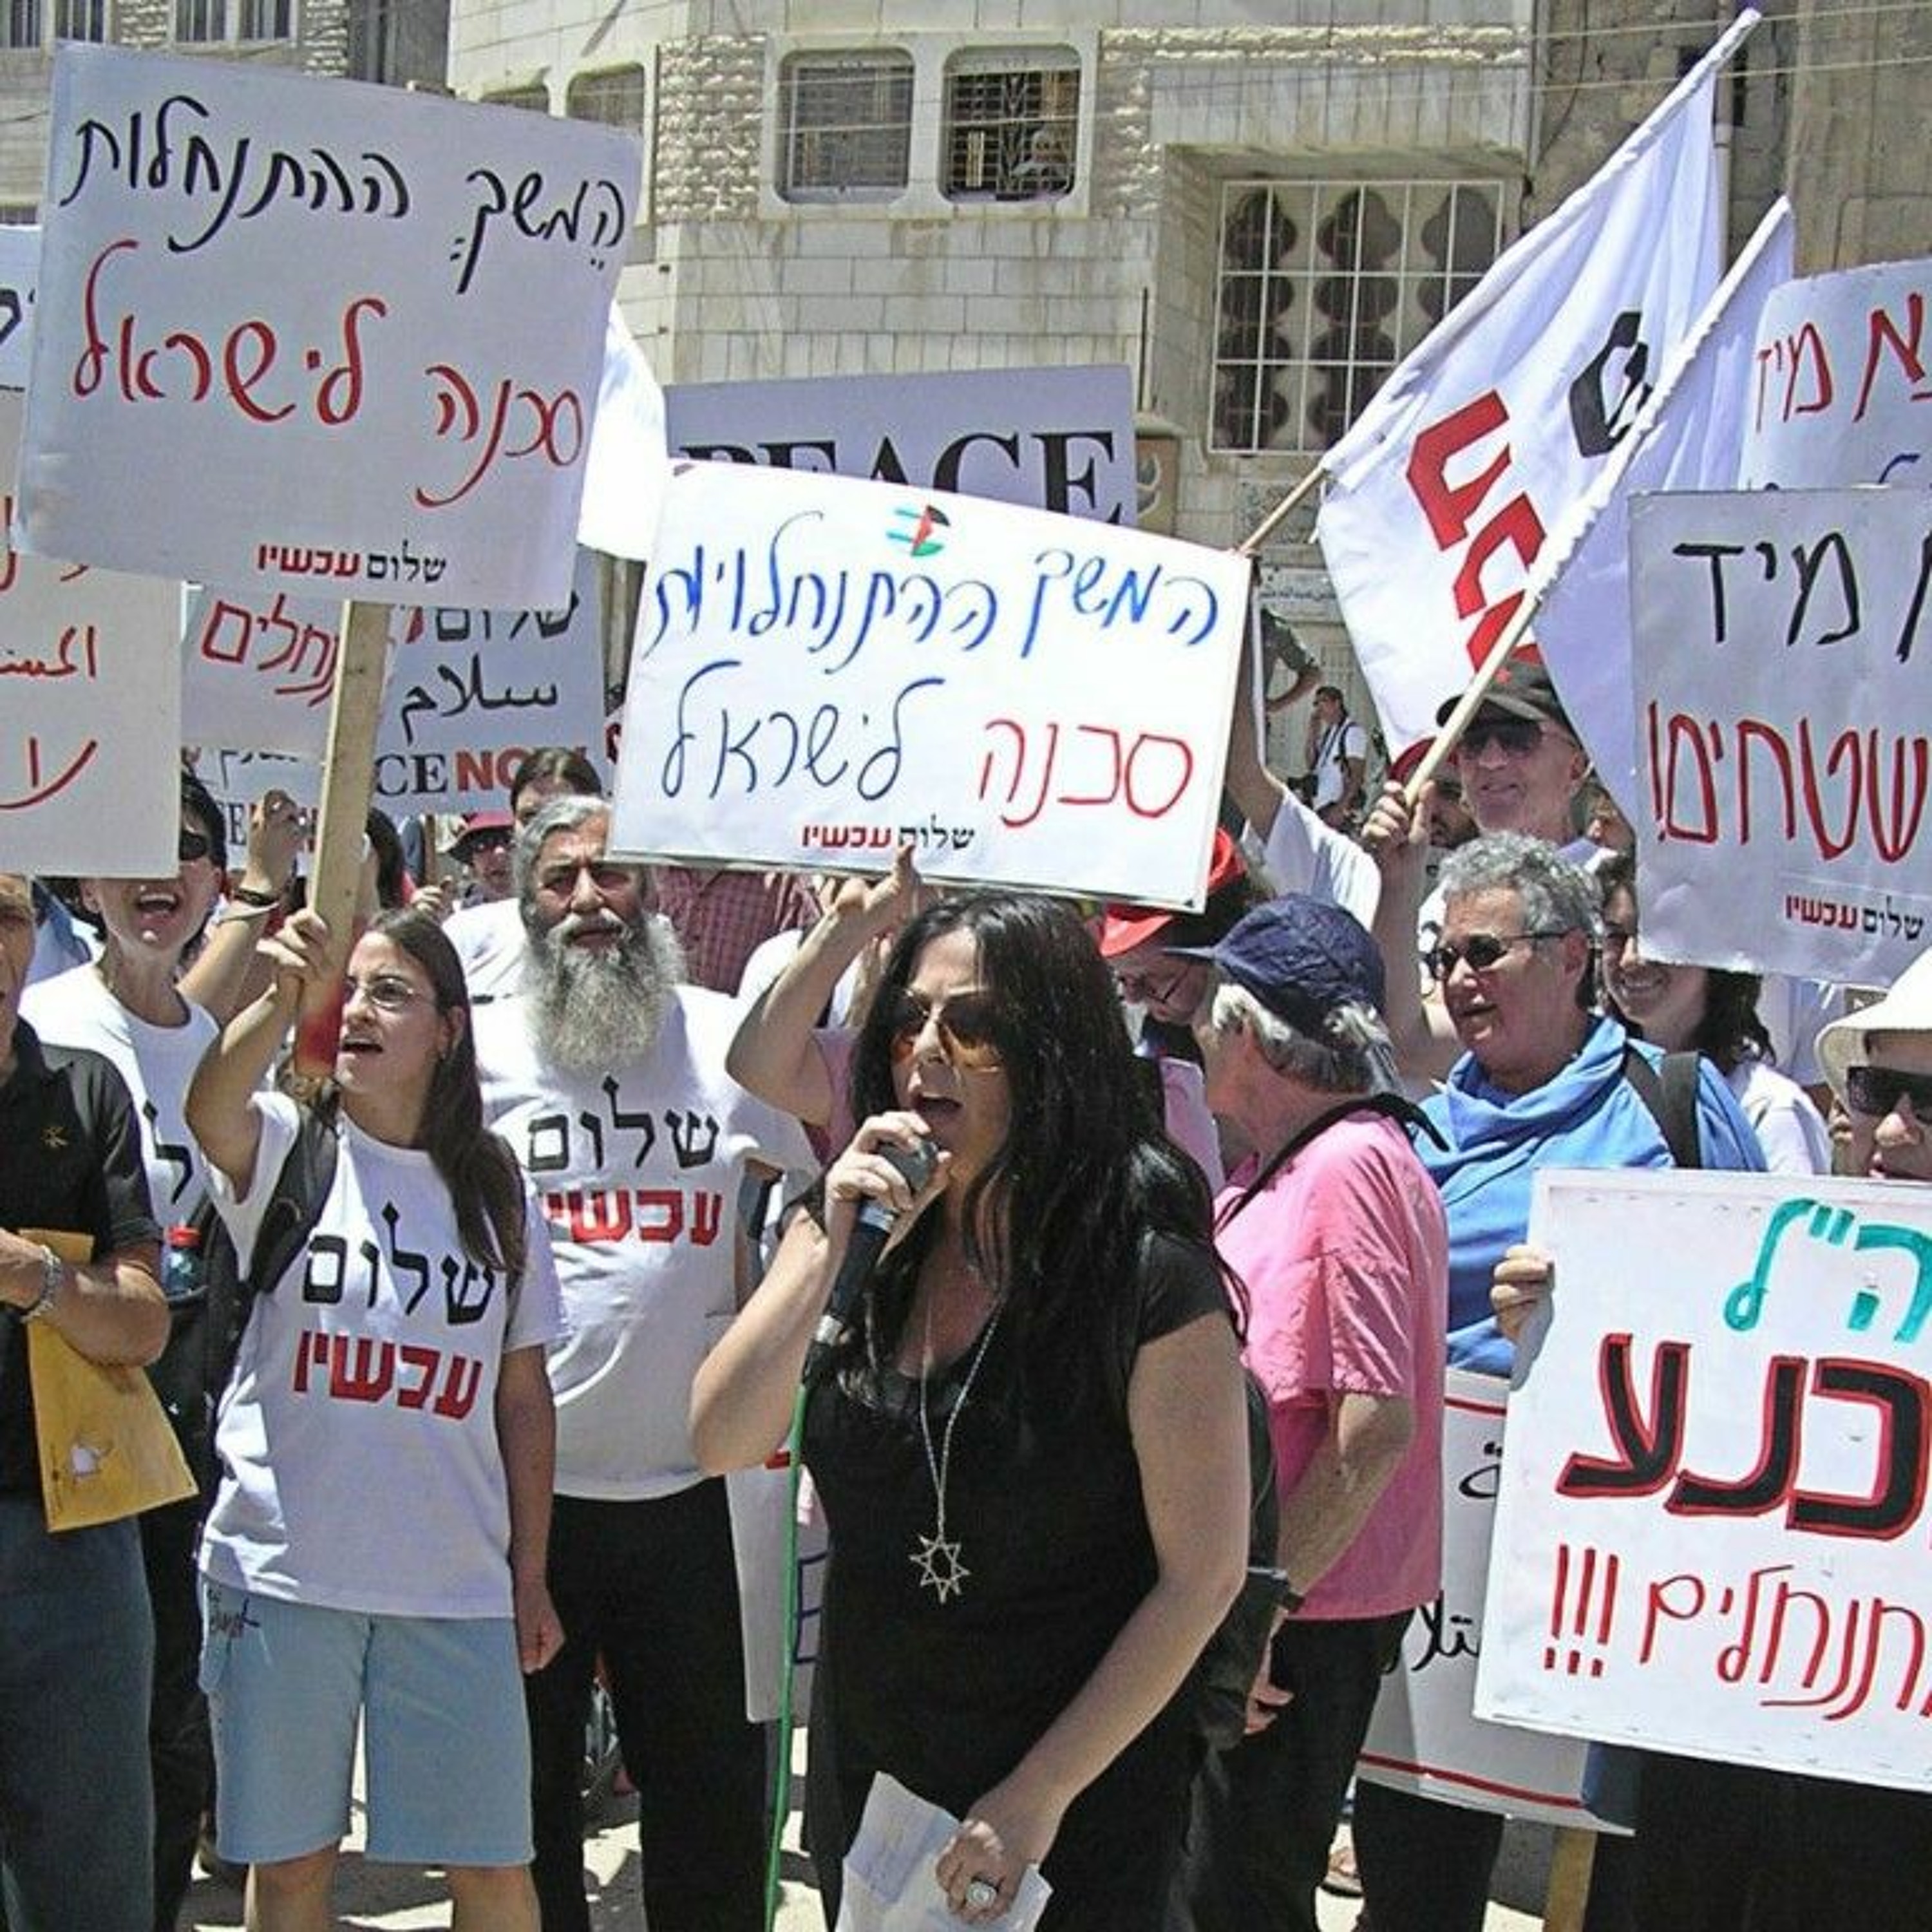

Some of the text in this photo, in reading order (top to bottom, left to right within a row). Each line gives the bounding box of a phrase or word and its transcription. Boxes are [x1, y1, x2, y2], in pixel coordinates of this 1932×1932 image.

[59, 95, 410, 252] ההתנחלות
[73, 240, 583, 507] סכנה לישראל
[1756, 322, 1833, 434] מיד
[258, 538, 446, 583] שלום עכשיו
[643, 511, 1220, 675] המשך ההתנחלויות
[1672, 531, 1861, 647] מיד
[401, 652, 558, 747] سلام
[661, 660, 1195, 828] סכנה לישראל
[802, 825, 892, 848] עכשיו
[1786, 895, 1924, 941] שלום עכשיו
[528, 1076, 720, 1172] שלום
[303, 1201, 496, 1325] שלום
[540, 1189, 723, 1247] עכשי
[294, 1330, 483, 1421] עכשיו
